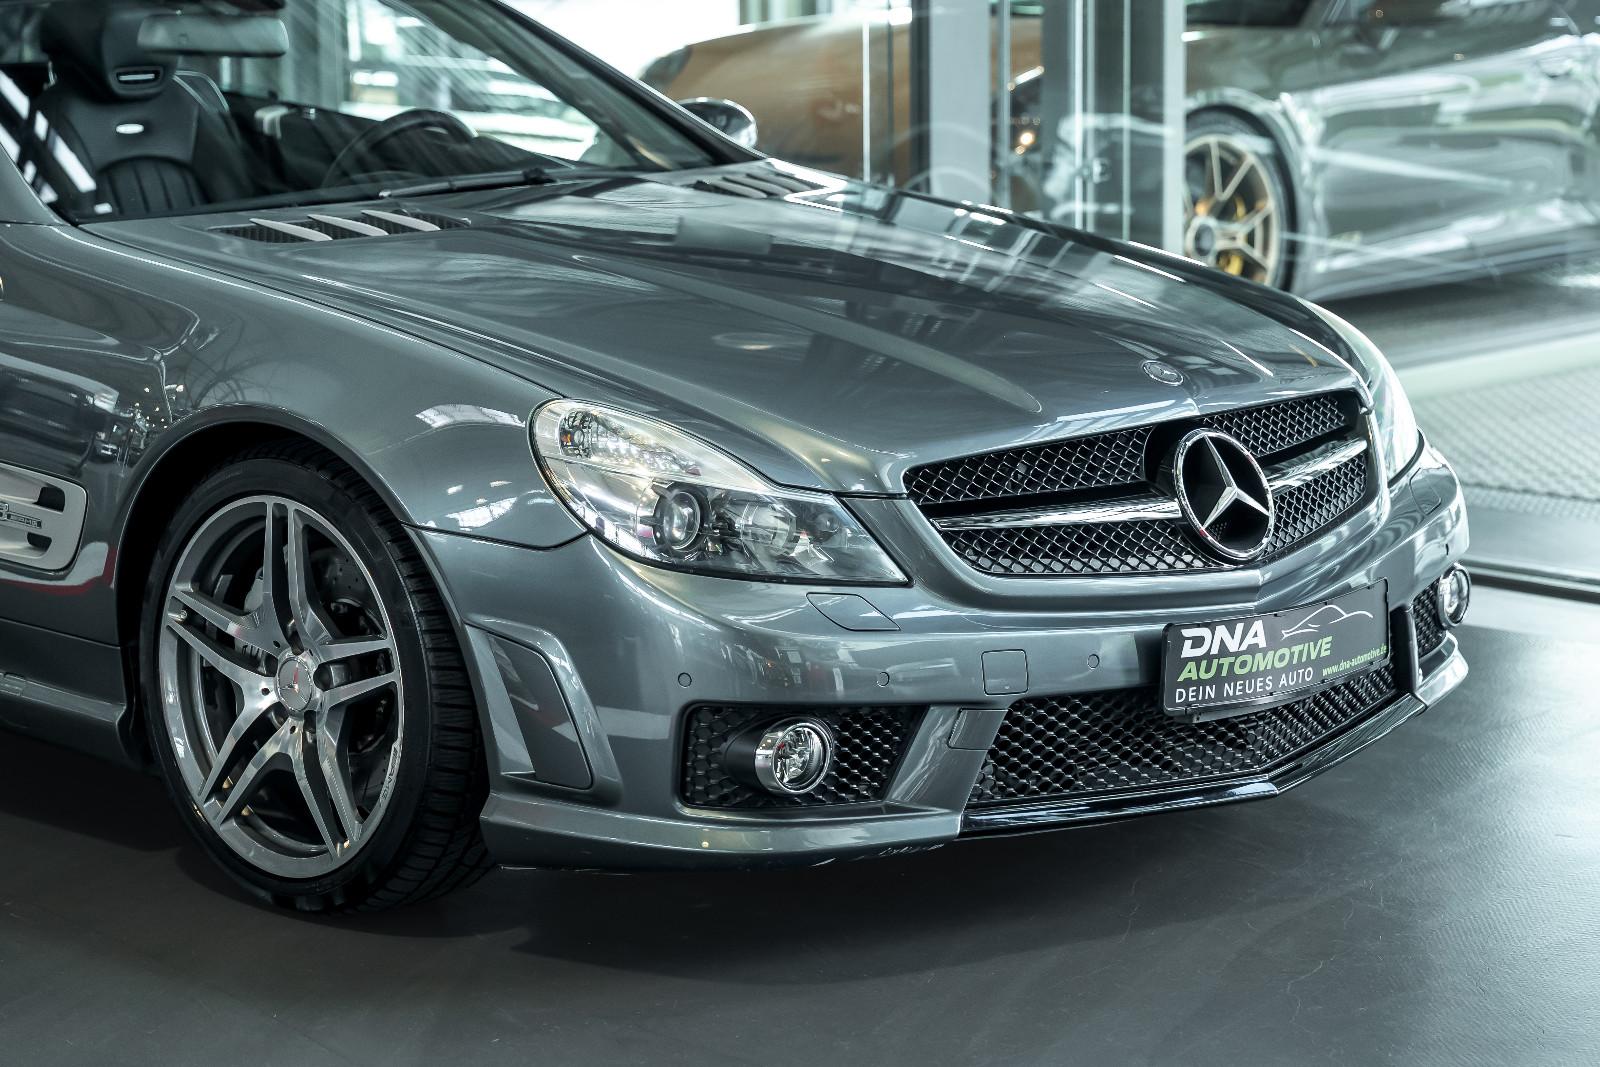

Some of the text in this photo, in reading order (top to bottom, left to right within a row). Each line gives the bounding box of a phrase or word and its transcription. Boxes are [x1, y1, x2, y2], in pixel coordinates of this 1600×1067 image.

[1180, 619, 1267, 659] DNA
[1177, 636, 1333, 682] AUTOMOTIVE
[1322, 643, 1388, 677] www.dna-automotive.de
[1175, 667, 1314, 704] DEIN NEUES AUTO
